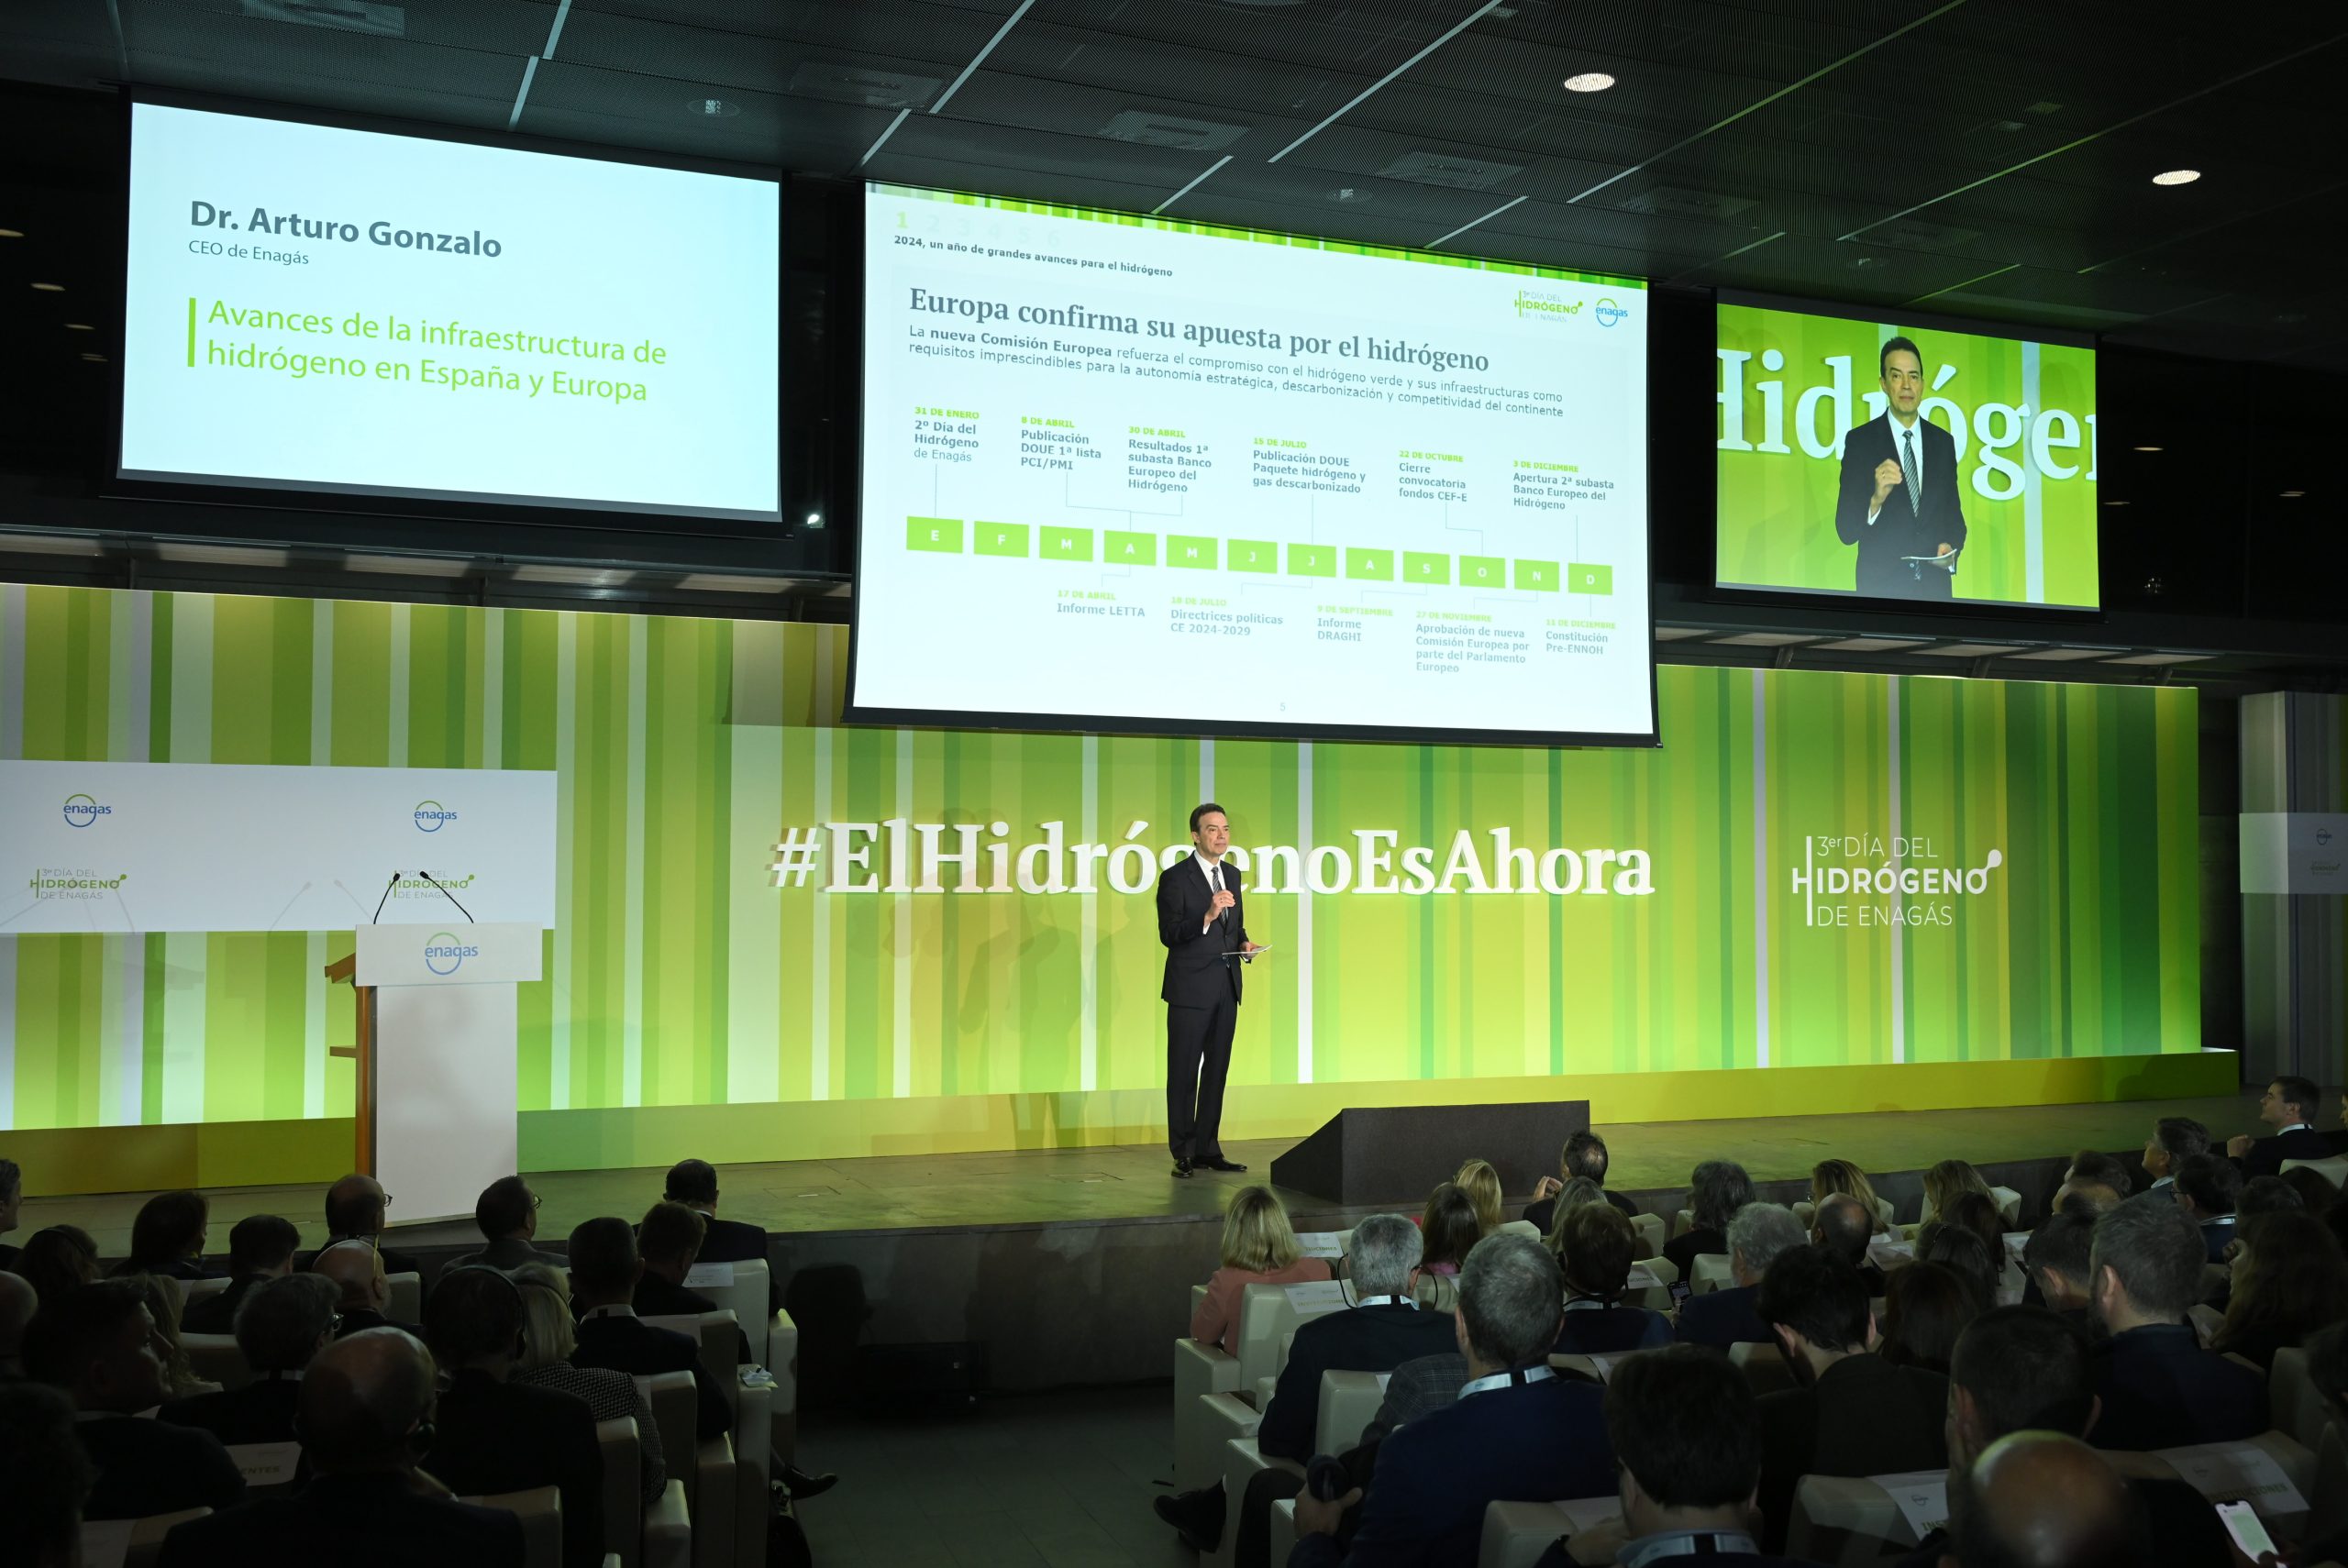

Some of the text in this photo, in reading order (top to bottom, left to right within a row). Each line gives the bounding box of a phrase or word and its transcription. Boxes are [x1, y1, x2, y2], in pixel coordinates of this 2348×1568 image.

[897, 211, 908, 229] 1
[191, 200, 502, 258] Dr. Arturo Gonzalo
[188, 239, 309, 266] CEO de Enagás
[894, 235, 1173, 277] 2024, un año de grandes avances para el hidrógeno
[1596, 306, 1628, 317] enagas
[207, 300, 667, 365] Avances de la infraestructura de
[909, 287, 1489, 372] Europa confirma su apuesta por el hidrógeno
[208, 338, 647, 405] hidrógeno en España y Europa
[910, 324, 1563, 403] La nueva Comisión Europea refuerza el compromiso con el hidrógeno verde y sus infraestructuras como
[909, 343, 1564, 417] requisitos imprescindibles para la autonomía estratégica, descarbonización y competitividad del continente
[914, 406, 980, 420] 31 DE ENERO
[933, 421, 954, 433] Día
[957, 423, 976, 435] del
[914, 433, 980, 449] Hidrógeno
[1021, 429, 1090, 445] Publicación
[1021, 442, 1055, 455] DOUE
[1076, 447, 1102, 458] lista
[1128, 438, 1192, 454] Resultados
[914, 447, 972, 463] de Enagás
[1128, 453, 1212, 468] subasta Banco
[1253, 449, 1349, 467] Publicación DOUE
[1021, 457, 1073, 470] PCI/PMI
[1399, 462, 1431, 474] Cierre
[1128, 465, 1197, 480] Europeo del
[1253, 462, 1366, 483] Paquete hidrógeno y
[1128, 478, 1188, 493] Hidrógeno
[1253, 477, 1361, 493] gas descarbonizado
[1399, 476, 1467, 489] convocatoria
[1512, 472, 1558, 485] Apertura
[1575, 478, 1614, 490] subasta
[1399, 487, 1468, 502] fondos CEF-E
[1513, 484, 1606, 501] Banco Europeo del
[1513, 496, 1566, 511] Hidrógeno
[930, 529, 1596, 586] E F M A M J J A S O N D
[63, 805, 112, 815] enagas
[414, 811, 458, 820] enagas
[1844, 833, 1885, 857] DÍA
[1893, 836, 1938, 857] DEL
[771, 817, 1656, 896] #ElHidrónoEsAhora
[29, 878, 120, 889] HIDRÓGENO
[1792, 860, 1988, 895] HIDRÓGENO
[1818, 901, 1953, 927] DE ENAGÁS
[425, 945, 479, 957] enagas
